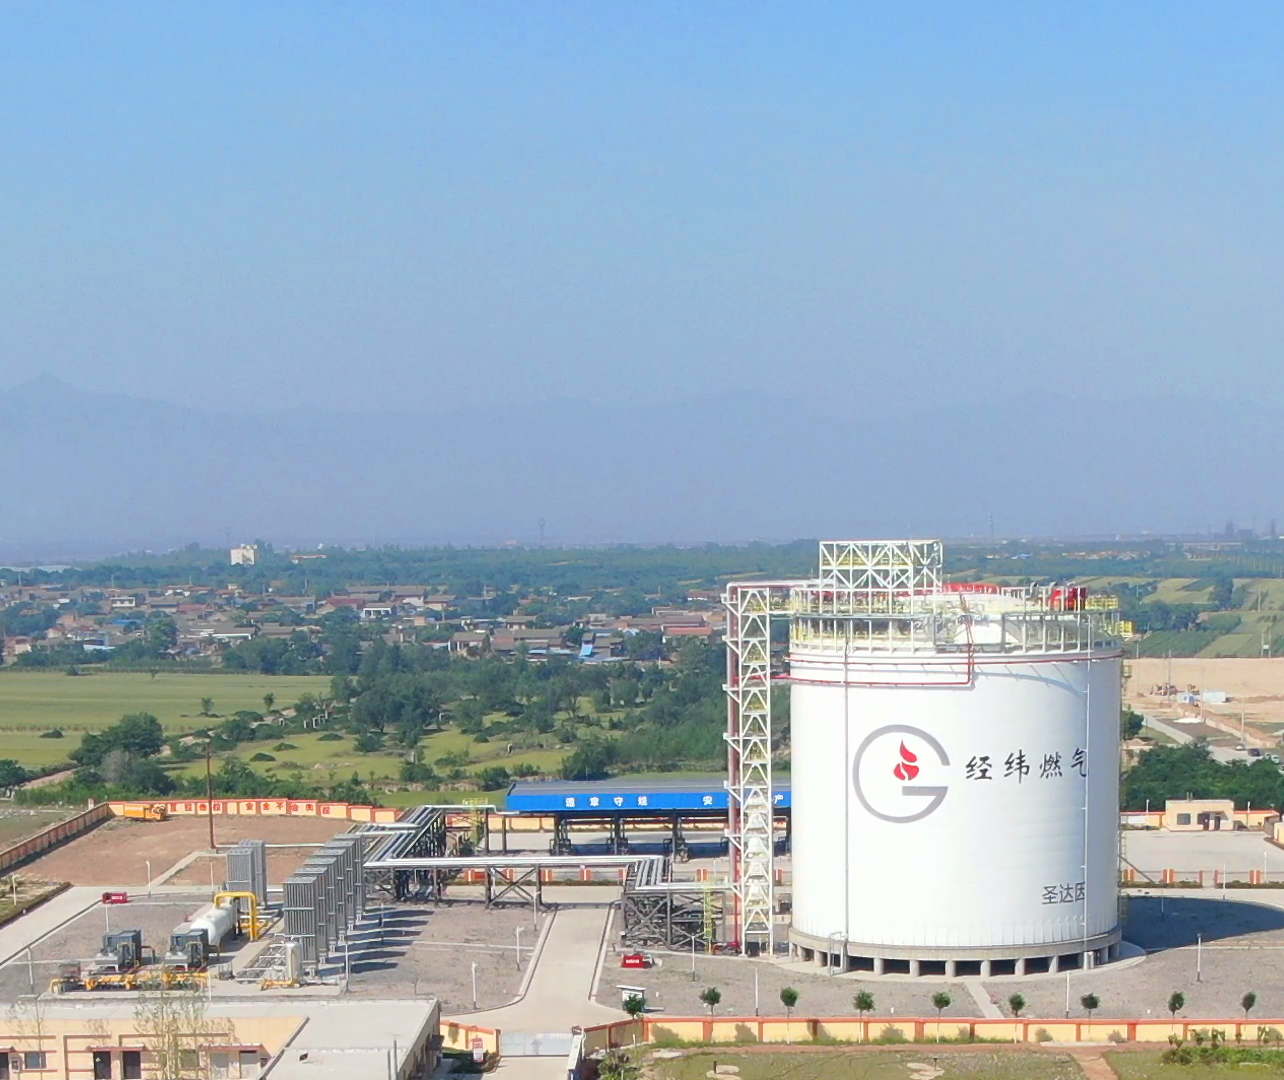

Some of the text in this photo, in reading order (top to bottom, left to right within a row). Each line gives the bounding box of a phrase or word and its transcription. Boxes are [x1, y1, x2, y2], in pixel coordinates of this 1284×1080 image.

[965, 747, 1087, 784] 经纬燃气
[1042, 881, 1086, 905] 圣达因
